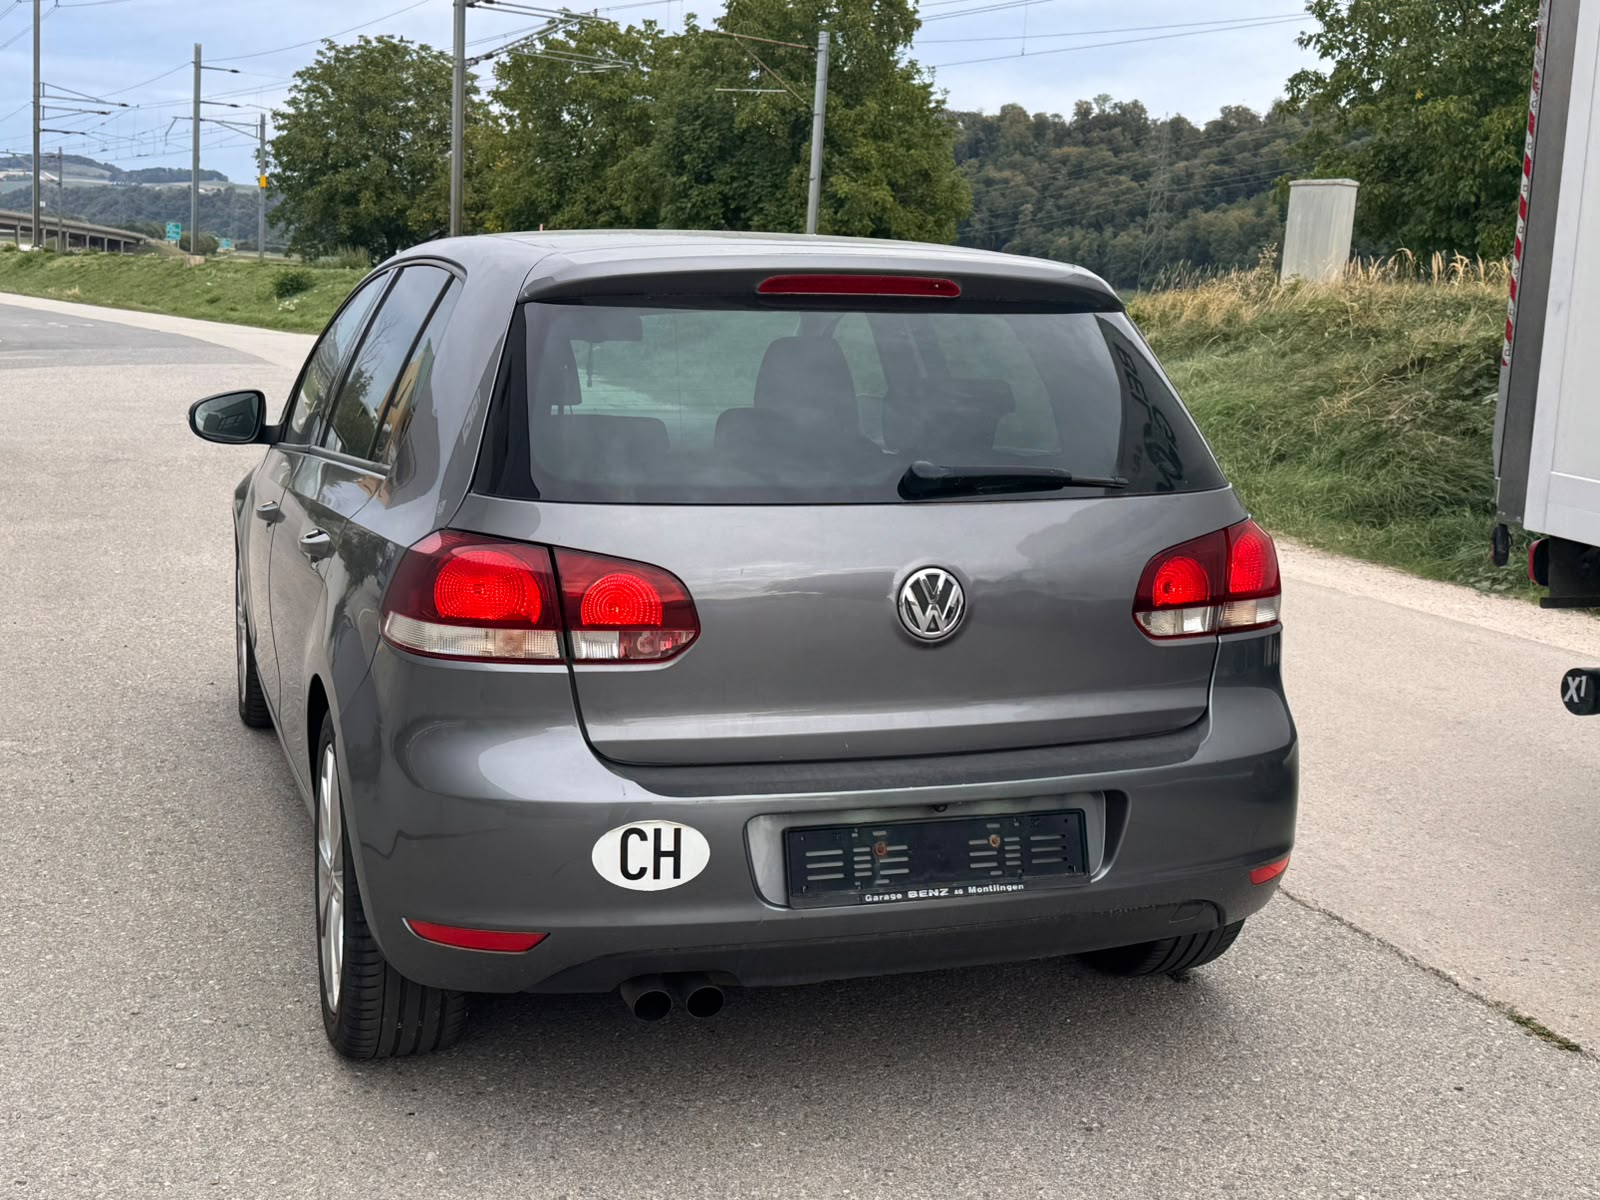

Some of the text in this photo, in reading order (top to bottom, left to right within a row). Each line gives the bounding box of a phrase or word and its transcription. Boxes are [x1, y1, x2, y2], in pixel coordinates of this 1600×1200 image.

[620, 827, 682, 881] CH
[865, 893, 903, 902] Garage
[907, 888, 949, 898] BENZ
[967, 884, 1024, 894] Montlingen
